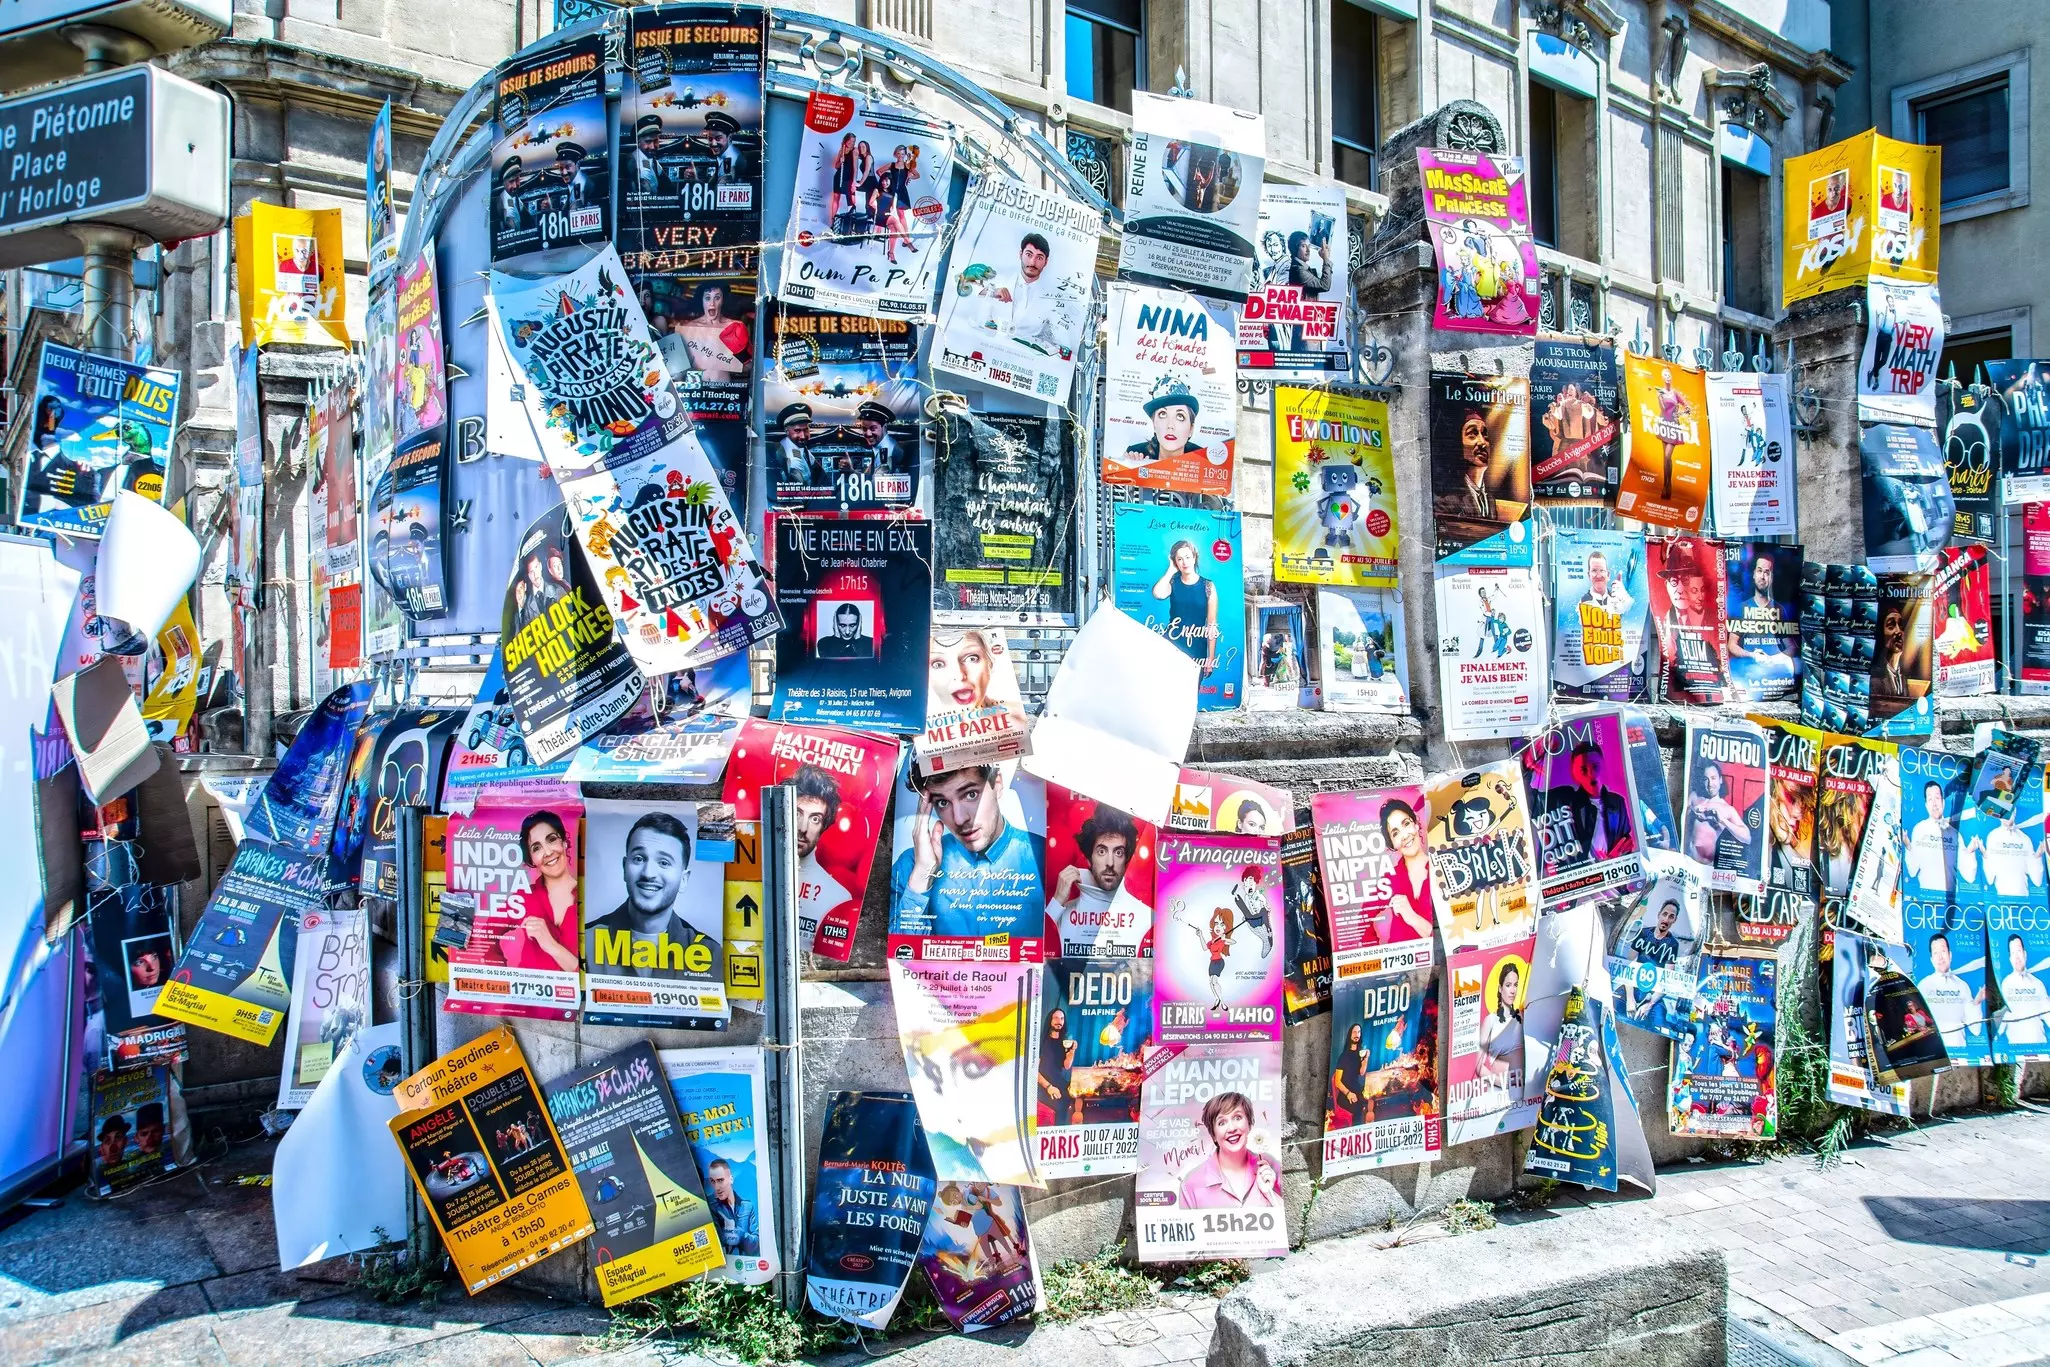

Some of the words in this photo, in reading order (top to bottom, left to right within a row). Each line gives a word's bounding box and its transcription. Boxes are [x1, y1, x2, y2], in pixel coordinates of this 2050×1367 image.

[635, 28, 671, 48] ISSUE
[674, 27, 691, 45] DE
[694, 26, 760, 44] SECOURS
[500, 74, 528, 97] ISSUE
[529, 68, 544, 85] DE
[544, 54, 596, 81] SECOURS
[32, 95, 134, 143] Piétonne
[11, 150, 67, 181] Place
[681, 182, 715, 211] 18h
[719, 191, 727, 203] LE
[729, 190, 750, 203] PARIS
[539, 212, 569, 241] 18h
[654, 227, 717, 246] VERY
[624, 251, 689, 270] BRAD
[702, 250, 754, 270] PITT
[787, 283, 814, 298] 10H10
[1267, 288, 1298, 302] PAR
[1245, 296, 1337, 323] DEWAERE
[774, 317, 818, 335] ISSUE
[820, 317, 838, 333] DE
[841, 317, 907, 333] SECOURS
[1136, 303, 1208, 342] NINA
[1306, 323, 1335, 337] MOI
[531, 306, 628, 362] AUGUSTIN
[1894, 322, 1934, 349] VERY
[1137, 335, 1158, 349] des
[1162, 339, 1208, 356] tomates
[1549, 347, 1565, 358] LES
[1567, 348, 1591, 359] TROIS
[46, 352, 76, 371] DEUX
[79, 360, 127, 381] HOMMES
[1136, 350, 1146, 360] et
[1148, 354, 1171, 364] des
[1176, 356, 1214, 370] bombes
[1535, 359, 1608, 371] MOUSQUETAIRES
[1888, 349, 1937, 375] MATH
[1891, 368, 1924, 395] TRIP
[76, 374, 125, 400] TOUT
[123, 375, 173, 413] NUS
[1446, 385, 1460, 401] Le
[1464, 387, 1527, 406] Souffleur
[458, 416, 487, 464] B
[997, 464, 1022, 473] Giono
[1727, 470, 1778, 479] FINALEMENT,
[836, 473, 873, 502] 18h
[877, 481, 886, 493] LE
[888, 479, 909, 493] PARIS
[789, 530, 817, 551] UNE
[821, 530, 863, 551] REINE
[867, 530, 884, 551] EN
[889, 530, 919, 551] EXIL
[821, 558, 828, 567] de
[830, 557, 860, 568] Jean-Paul
[861, 558, 887, 568] Chabrier
[840, 576, 868, 591] 17h15
[1886, 586, 1932, 599] Souffleur
[1579, 603, 1622, 629] VOLE
[1743, 606, 1780, 620] MERCI
[504, 586, 590, 672] SHERLOCK
[1583, 627, 1623, 647] EDDIE,
[1726, 622, 1799, 636] VASECTOMIE
[534, 604, 614, 678] HOLMES
[1460, 663, 1528, 672] FINALEMENT,
[1274, 683, 1295, 692] 15H30
[1460, 674, 1473, 683] JE
[1476, 674, 1496, 683] VAIS
[788, 688, 809, 698] Théâtre
[810, 689, 820, 697] des
[821, 689, 825, 697] 3
[827, 688, 847, 698] Raisins,
[849, 689, 856, 697] 15
[868, 688, 887, 698] Thiers,
[889, 688, 912, 699] Avignon
[1357, 689, 1378, 698] 15H30
[928, 726, 956, 744] ME
[961, 713, 1014, 737] PARLE
[614, 746, 692, 760] STORY
[776, 730, 865, 761] MATTHIEU
[1700, 734, 1761, 767] GOUROU
[461, 754, 498, 765] 21H55
[771, 744, 862, 776] PENCHINAT
[1778, 769, 1785, 778] 30
[1787, 771, 1812, 784] JUILLET
[1172, 805, 1182, 815] LA
[1531, 805, 1572, 828] VOUS
[1171, 815, 1209, 829] FACTORY
[454, 825, 482, 839] Leïla
[484, 826, 522, 840] Amara
[1537, 818, 1575, 850] DIT
[453, 840, 523, 864] INDO
[1160, 841, 1277, 866] L'Arnaqueuse
[1323, 832, 1385, 860] INDO
[1543, 840, 1581, 865] QUOI
[1327, 857, 1396, 882] MPTA
[453, 868, 532, 893] MPTA
[939, 887, 966, 897] mais
[969, 887, 990, 898] pas
[992, 887, 1030, 897] chiant
[1330, 879, 1393, 907] BLES
[1905, 902, 1984, 931] GREGG
[824, 925, 847, 938] 17H45
[594, 927, 712, 973] Mahé
[923, 940, 962, 960] THÉÂTRE
[963, 947, 974, 959] DES
[975, 941, 1009, 959] BRUNES
[1382, 953, 1414, 969] 17H30
[902, 969, 950, 982] Portrait
[953, 970, 968, 981] de
[971, 970, 1007, 983] Raoul
[1707, 965, 1717, 976] LE
[1720, 965, 1751, 979] MONDE
[172, 986, 198, 1000] Espace
[512, 982, 553, 997] 17H30
[653, 991, 698, 1007] 19H00
[1068, 973, 1132, 1005] DEDO
[1936, 989, 1960, 997] burnout
[1363, 982, 1410, 1019] DEDO
[1454, 994, 1481, 1008] FACTORY
[236, 1008, 257, 1020] 9H55
[1228, 1007, 1274, 1023] 14H10
[1373, 1016, 1398, 1027] BIAFINE
[1165, 1058, 1259, 1083] MANON
[432, 1070, 478, 1101] Théâtre
[410, 1108, 456, 1140] ANGÈLE
[1083, 1131, 1096, 1143] DU
[1099, 1130, 1111, 1142] 07
[1113, 1129, 1124, 1141] AU
[1127, 1128, 1138, 1140] 30
[1040, 1135, 1080, 1160] PARIS
[1082, 1143, 1114, 1156] JUILLET
[1116, 1141, 1137, 1154] 2022
[871, 1160, 906, 1172] KOLTÈS
[863, 1169, 886, 1185] LA
[892, 1171, 921, 1191] NUIT
[502, 1237, 510, 1246] à
[512, 1217, 546, 1241] 13h50
[846, 1210, 874, 1228] LES
[879, 1211, 921, 1236] FORÊTS
[1202, 1213, 1274, 1232] 15h20
[1145, 1224, 1156, 1243] LE
[1162, 1223, 1195, 1242] PARIS
[606, 1263, 633, 1278] Espace
